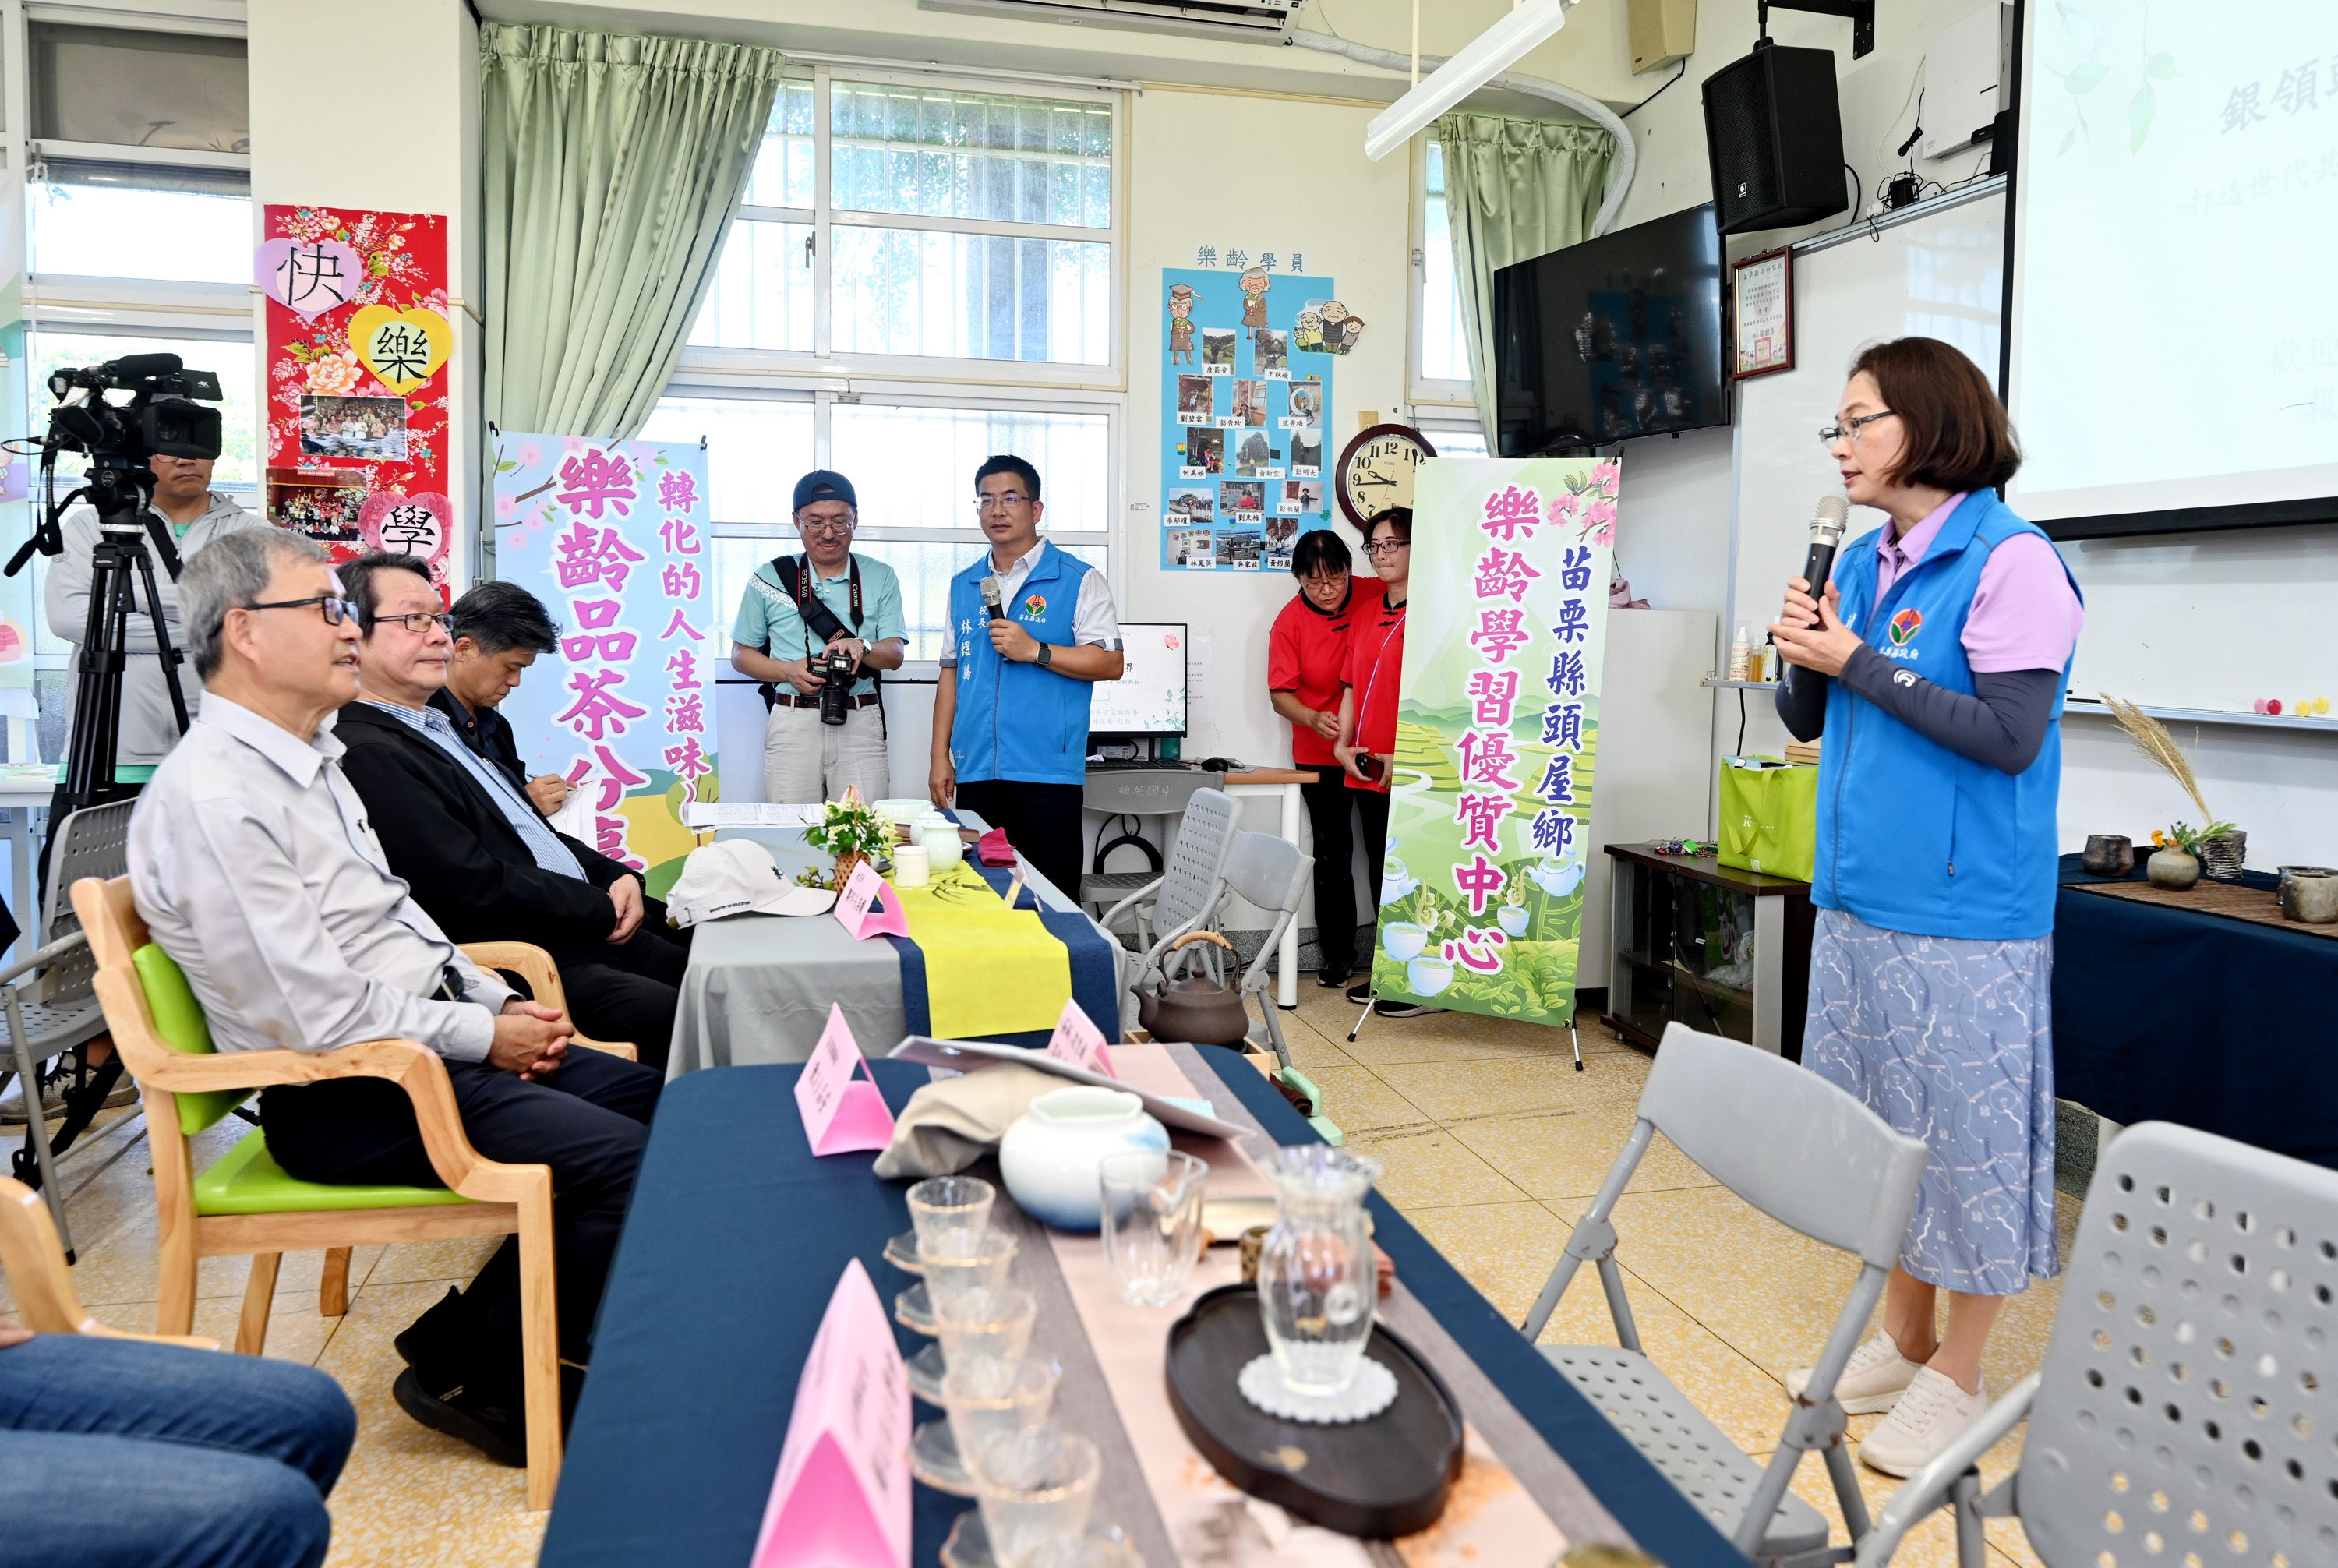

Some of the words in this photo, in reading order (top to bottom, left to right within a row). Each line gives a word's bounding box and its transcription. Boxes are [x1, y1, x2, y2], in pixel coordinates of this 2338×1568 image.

[2220, 52, 2338, 134] 銀領
[1196, 244, 1304, 273] 樂齡學員
[275, 244, 345, 308] 快
[372, 324, 429, 385] 樂
[1180, 414, 1203, 423] 劉碧雲
[1282, 418, 1304, 427] 范秀梅
[1370, 445, 1380, 458] 11
[1384, 441, 1399, 454] 12
[1404, 448, 1409, 461] 1
[1355, 457, 1372, 469] 10
[1294, 468, 1317, 477] 彭明光
[1352, 473, 1361, 486] 9
[1356, 490, 1365, 503] 8
[1367, 504, 1376, 517] 7
[380, 503, 436, 556] 學
[1190, 559, 1213, 567] 林鳳英
[978, 605, 988, 629] 校長
[1125, 662, 1135, 673] 界
[1532, 546, 1594, 857] 苗栗縣頭屋鄉
[1444, 484, 1544, 972] 樂齡學習優質中心
[1116, 786, 1173, 798] 頭屋國中
